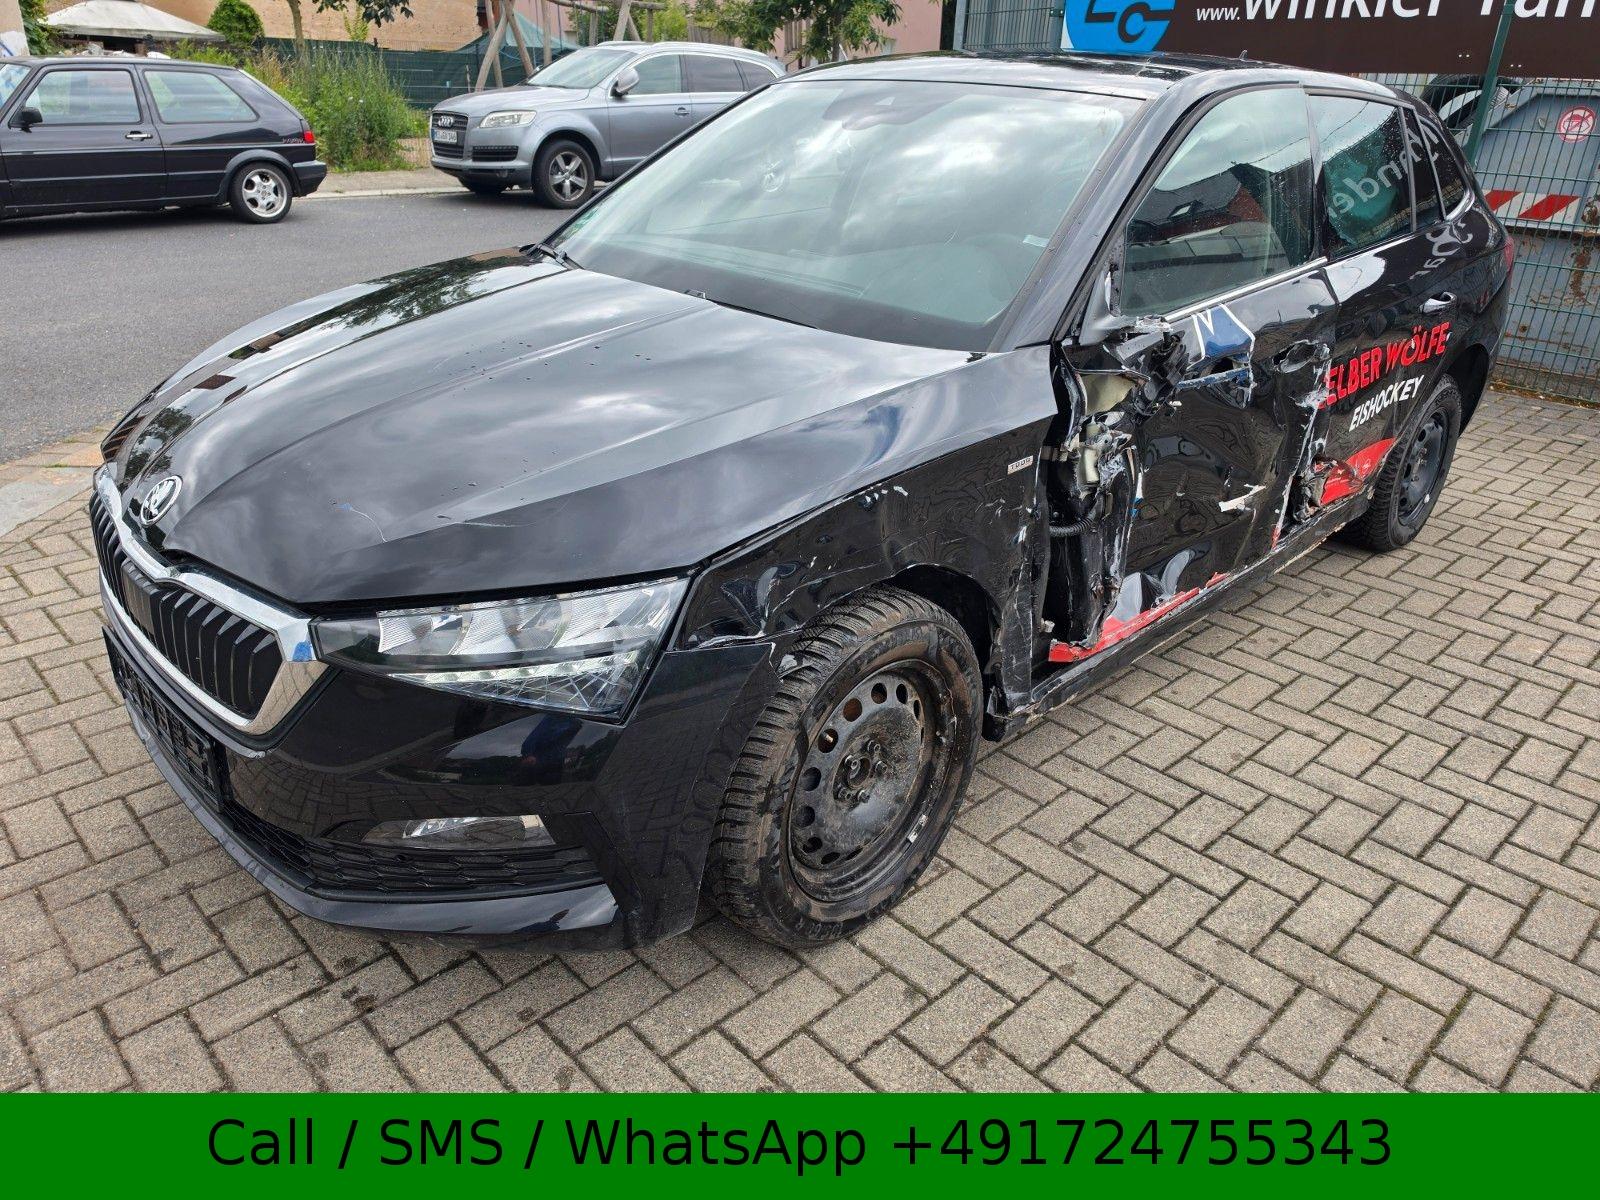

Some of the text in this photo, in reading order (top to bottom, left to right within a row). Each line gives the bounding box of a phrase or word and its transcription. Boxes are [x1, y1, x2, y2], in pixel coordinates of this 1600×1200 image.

[1318, 321, 1451, 410] ELBER WÖLFE
[1348, 374, 1425, 433] EISHOCKEY
